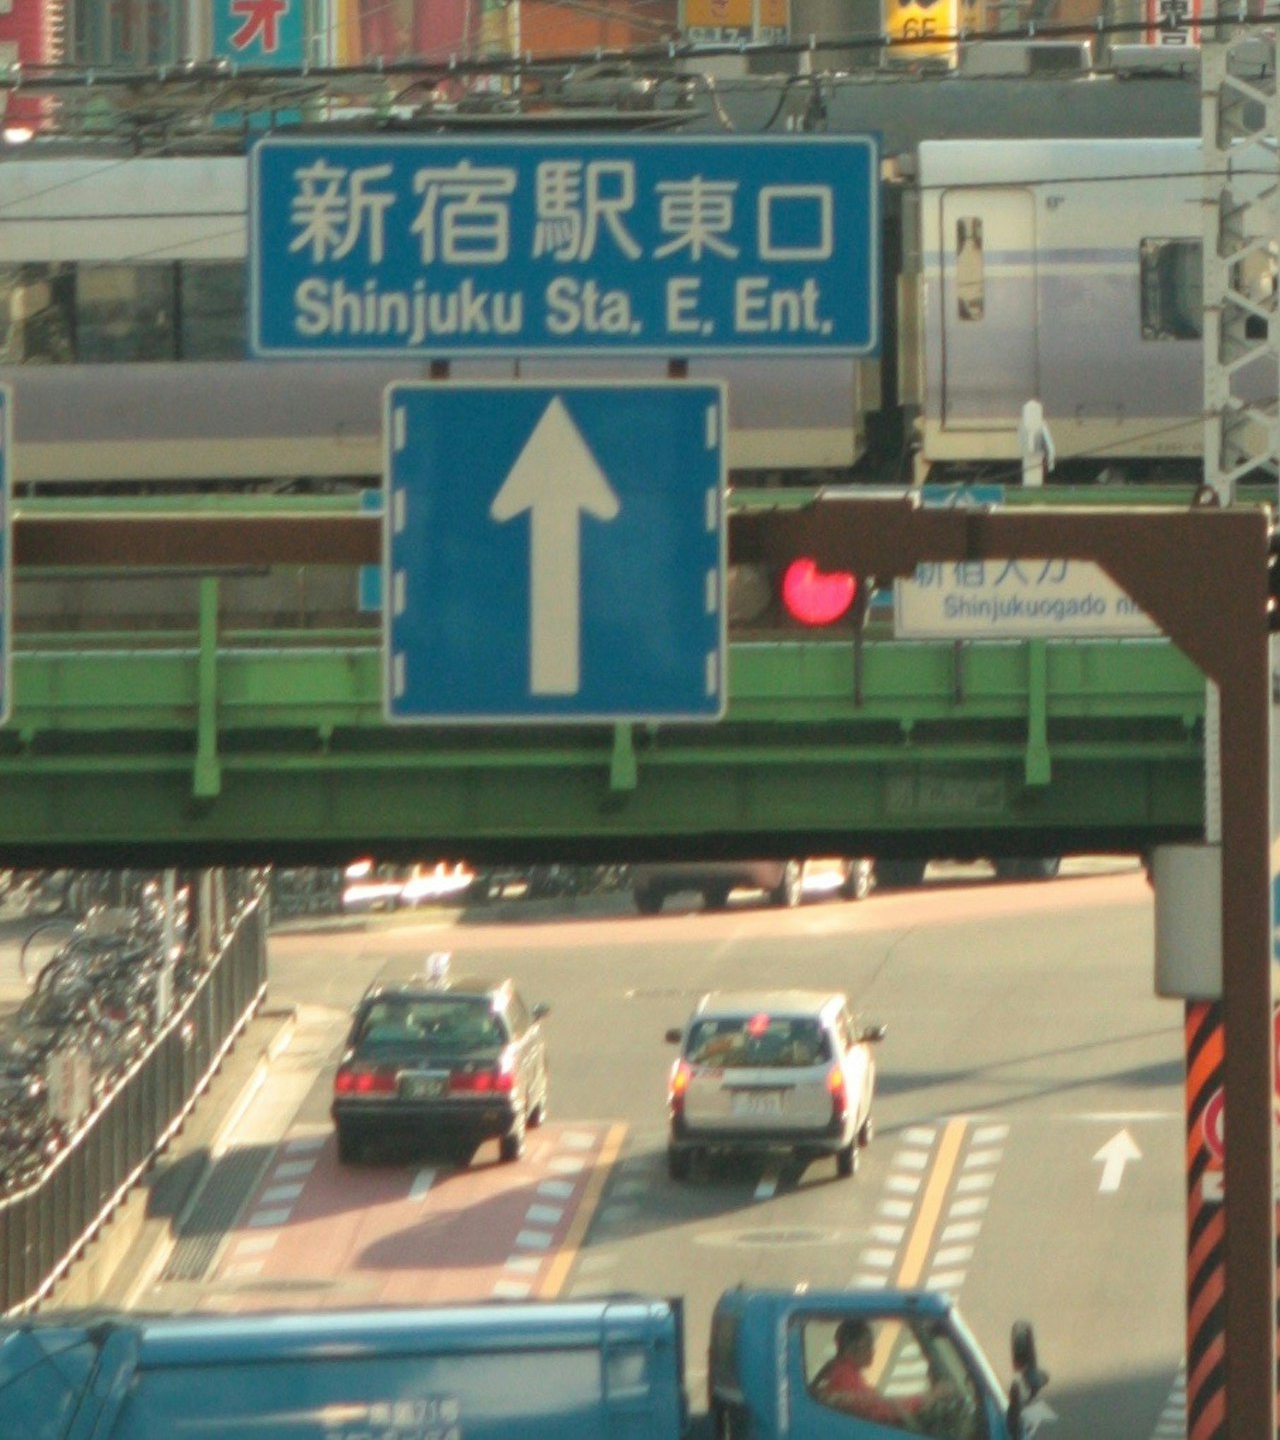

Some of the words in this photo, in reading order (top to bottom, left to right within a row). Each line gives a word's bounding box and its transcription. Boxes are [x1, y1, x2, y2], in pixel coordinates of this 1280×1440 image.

[290, 160, 836, 267] 新宿駅東口
[295, 277, 525, 346] Shinjuku
[546, 277, 643, 336] Sta.
[668, 277, 715, 337] E.
[736, 277, 835, 336] Ent.
[944, 594, 1107, 622] Shinjukuogado
